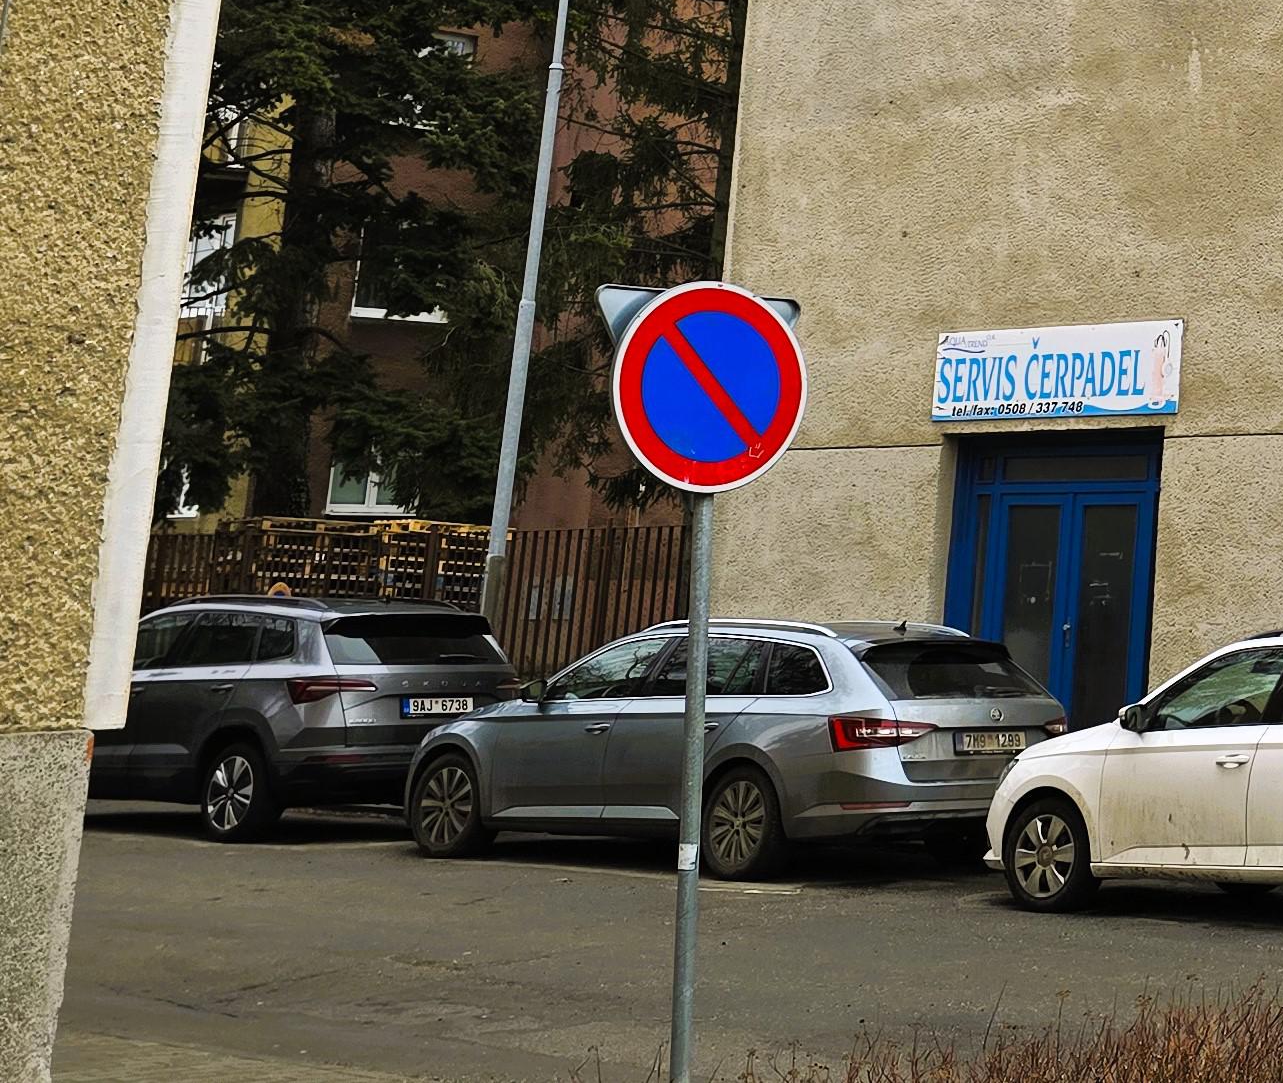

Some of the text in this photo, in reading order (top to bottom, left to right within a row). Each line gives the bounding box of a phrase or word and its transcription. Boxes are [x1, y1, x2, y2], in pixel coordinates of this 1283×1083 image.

[937, 336, 1145, 404] SERVIS ČERPADEL
[997, 403, 1026, 416] 0508
[1035, 401, 1059, 415] 337
[1060, 400, 1084, 413] 748
[412, 699, 469, 713] 9AJ 6738
[995, 733, 1021, 748] 1299
